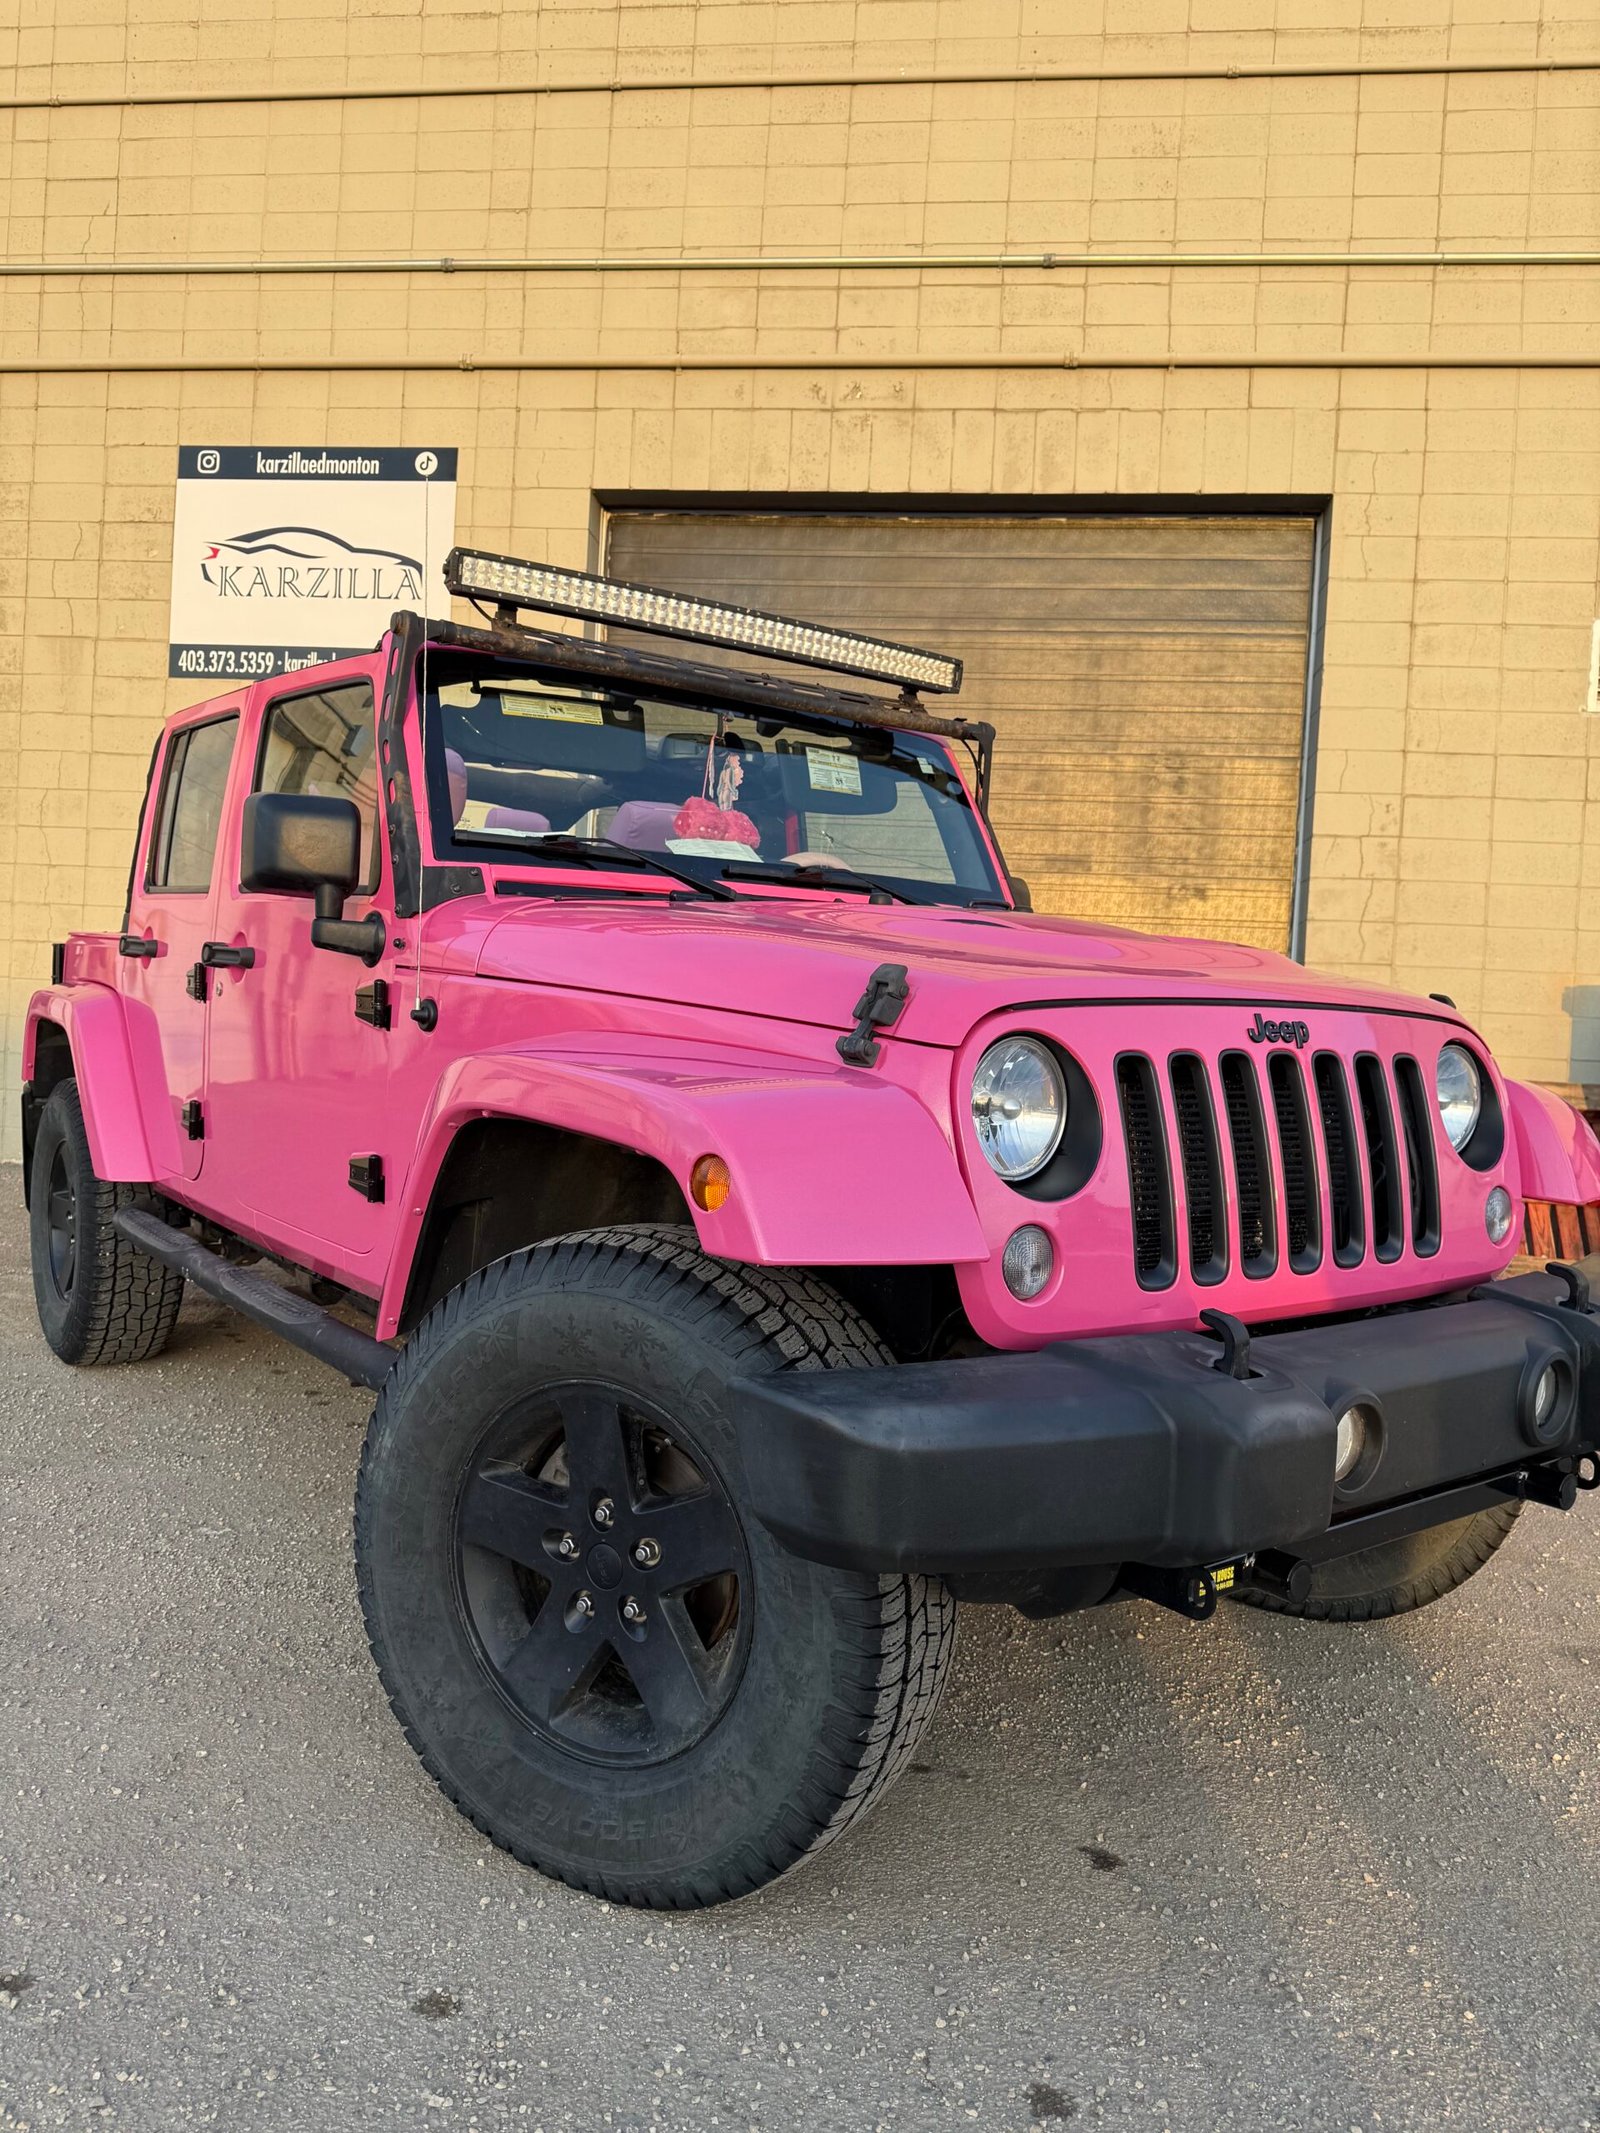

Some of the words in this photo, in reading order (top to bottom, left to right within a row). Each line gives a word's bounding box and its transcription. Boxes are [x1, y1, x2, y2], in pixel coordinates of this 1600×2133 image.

[256, 451, 380, 475] karzillaedmonton
[218, 565, 423, 600] KARZILLA
[178, 649, 275, 673] 403.373.5359
[1248, 1013, 1310, 1049] Jeep
